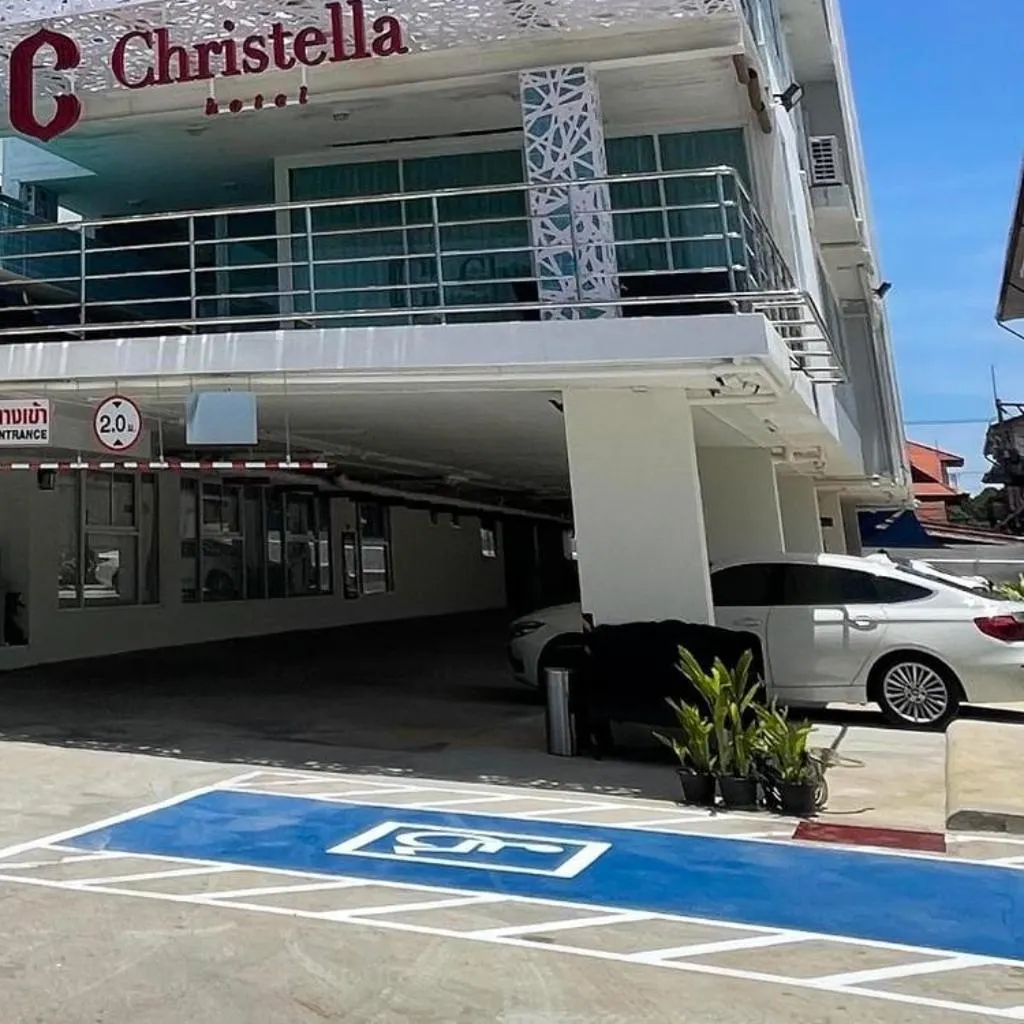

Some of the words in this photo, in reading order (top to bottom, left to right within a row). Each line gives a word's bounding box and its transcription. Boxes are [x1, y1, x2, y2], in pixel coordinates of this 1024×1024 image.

[9, 29, 81, 142] C
[111, 0, 407, 89] Christella
[100, 414, 126, 433] 2.0
